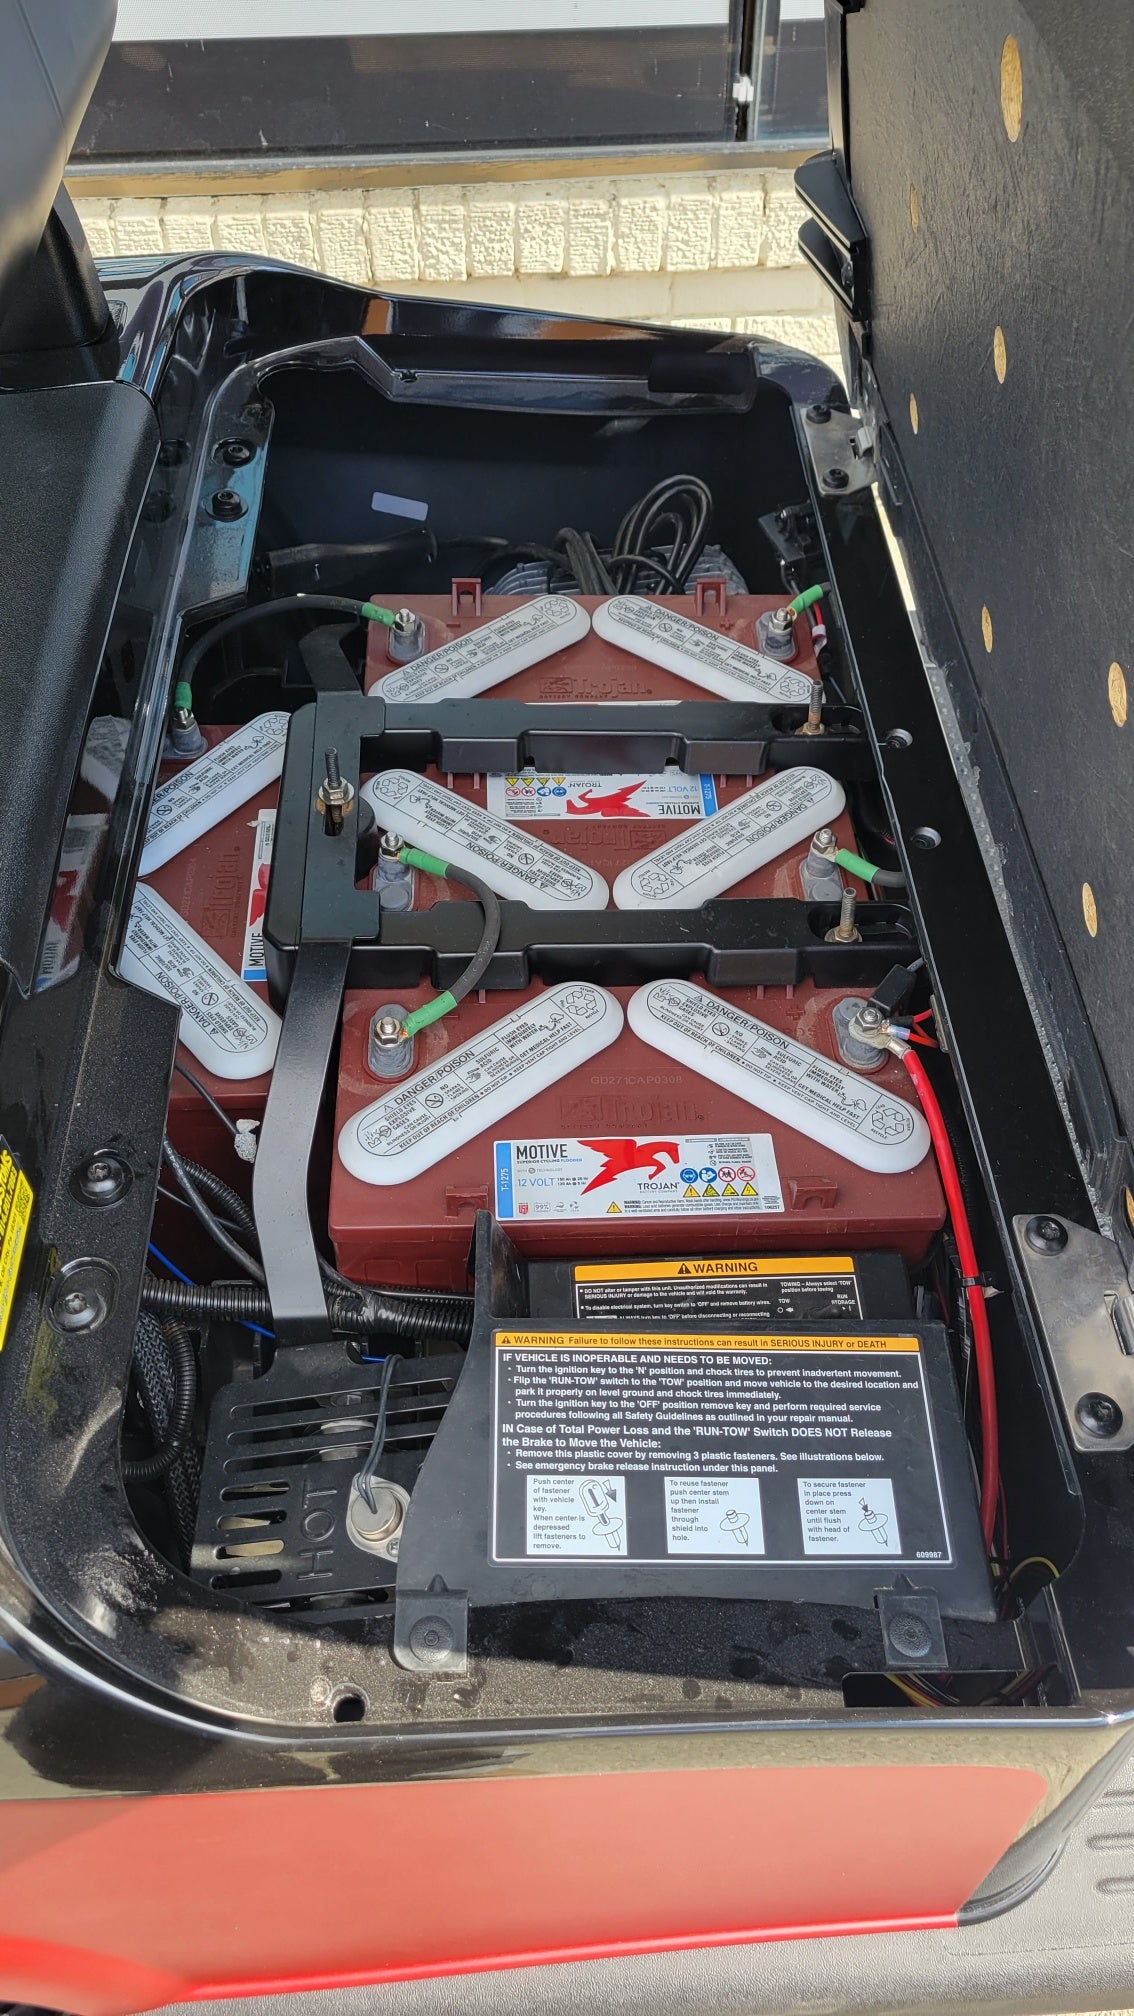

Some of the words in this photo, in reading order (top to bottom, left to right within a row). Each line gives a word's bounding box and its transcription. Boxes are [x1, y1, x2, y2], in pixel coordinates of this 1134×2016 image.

[654, 608, 718, 641] DANGER/POISON
[410, 636, 472, 671] DANGER/POISON
[658, 804, 701, 814] MOTIVE
[745, 802, 807, 844] DANGER/POISON
[466, 840, 537, 884] DANGER/POISON
[155, 970, 210, 1028] DANGER/POISON
[501, 1028, 516, 1041] FLUSH
[516, 1021, 528, 1031] EYES
[505, 1022, 536, 1044] IMMEDIATELY
[706, 1000, 789, 1049] DANGER/POISON
[509, 1038, 522, 1048] WITH
[522, 1027, 538, 1040] WATER
[528, 1036, 549, 1052] MEDICAL
[549, 1028, 561, 1039] HELP
[560, 1021, 572, 1031] FAST
[660, 1014, 673, 1024] KEEP
[690, 1031, 708, 1043] REACH
[715, 1044, 740, 1062] CHILDREN
[394, 1049, 475, 1105] DANGER/POISON
[384, 1107, 403, 1121] SHIELD
[402, 1099, 416, 1110] EYES
[808, 1088, 832, 1104] MEDICAL
[832, 1102, 846, 1112] HELP
[845, 1109, 860, 1120] FAST
[388, 1105, 416, 1126] EXPLOSIVE
[392, 1116, 409, 1130] GASES
[399, 1137, 412, 1148] KEEP
[430, 1114, 447, 1128] REACH
[454, 1093, 479, 1112] CHILDREN
[516, 1144, 568, 1160] MOTIVE
[500, 1168, 509, 1192] T-1275
[518, 1178, 527, 1187] 12
[530, 1178, 555, 1187] VOLT
[637, 1182, 678, 1190] TROJAN
[694, 1262, 758, 1274] WARNING
[514, 1336, 564, 1345] WARNING
[569, 1336, 598, 1345] Failure
[611, 1337, 636, 1345] follow
[638, 1337, 661, 1346] these
[664, 1338, 714, 1346] instructions
[735, 1339, 757, 1347] result
[761, 1339, 768, 1347] in
[771, 1339, 810, 1347] SERIOUS
[812, 1340, 844, 1348] INJURY
[858, 1340, 886, 1348] DEATH
[503, 1353, 512, 1361] IF
[514, 1353, 558, 1361] VEHICLE
[560, 1353, 570, 1362] IS
[572, 1354, 637, 1362] INOPERABLE
[639, 1354, 661, 1363] AND
[663, 1355, 697, 1363] NEEDS
[699, 1355, 713, 1364] TO
[716, 1355, 730, 1364] BE
[732, 1356, 771, 1365] MOVED:
[513, 1375, 530, 1385] Flip
[532, 1376, 546, 1384] the
[548, 1376, 597, 1384] 'RUN-TOW'
[599, 1377, 629, 1385] switch
[630, 1377, 640, 1385] to
[641, 1377, 656, 1385] the
[658, 1377, 684, 1385] 'TOW'
[686, 1378, 722, 1388] position
[769, 1379, 801, 1387] vehicle
[813, 1380, 828, 1388] the
[830, 1380, 863, 1388] desired
[864, 1380, 900, 1388] location
[515, 1364, 536, 1372] Turn
[538, 1365, 552, 1373] the
[554, 1365, 588, 1375] ignition
[590, 1365, 606, 1375] key
[618, 1366, 633, 1374] the
[635, 1366, 646, 1374] 'N'
[649, 1366, 684, 1376] position
[686, 1367, 703, 1375] and
[705, 1367, 732, 1375] chock
[733, 1368, 754, 1376] tires
[755, 1368, 765, 1376] to
[766, 1369, 800, 1378] prevent
[802, 1368, 851, 1377] inadvertent
[502, 1423, 513, 1433] IN
[516, 1423, 543, 1433] Case
[545, 1424, 556, 1433] of
[558, 1424, 584, 1433] Total
[587, 1424, 620, 1434] Power
[623, 1425, 649, 1434] Loss
[651, 1425, 671, 1435] and
[673, 1426, 691, 1435] the
[693, 1426, 750, 1436] 'RUN-TOW'
[753, 1427, 788, 1436] Switch
[791, 1427, 822, 1437] DOES
[824, 1427, 847, 1437] NOT
[850, 1428, 892, 1437] Release
[501, 1437, 519, 1446] the
[521, 1437, 553, 1446] Brake
[554, 1437, 566, 1446] to
[569, 1437, 597, 1447] Move
[599, 1438, 617, 1447] the
[619, 1438, 660, 1448] Vehicle:
[515, 1461, 533, 1469] See
[534, 1462, 585, 1471] emergency
[588, 1462, 614, 1470] brake
[615, 1462, 649, 1470] release
[651, 1462, 700, 1471] instruction
[702, 1463, 729, 1471] under
[730, 1463, 748, 1472] this
[750, 1464, 778, 1473] panel.
